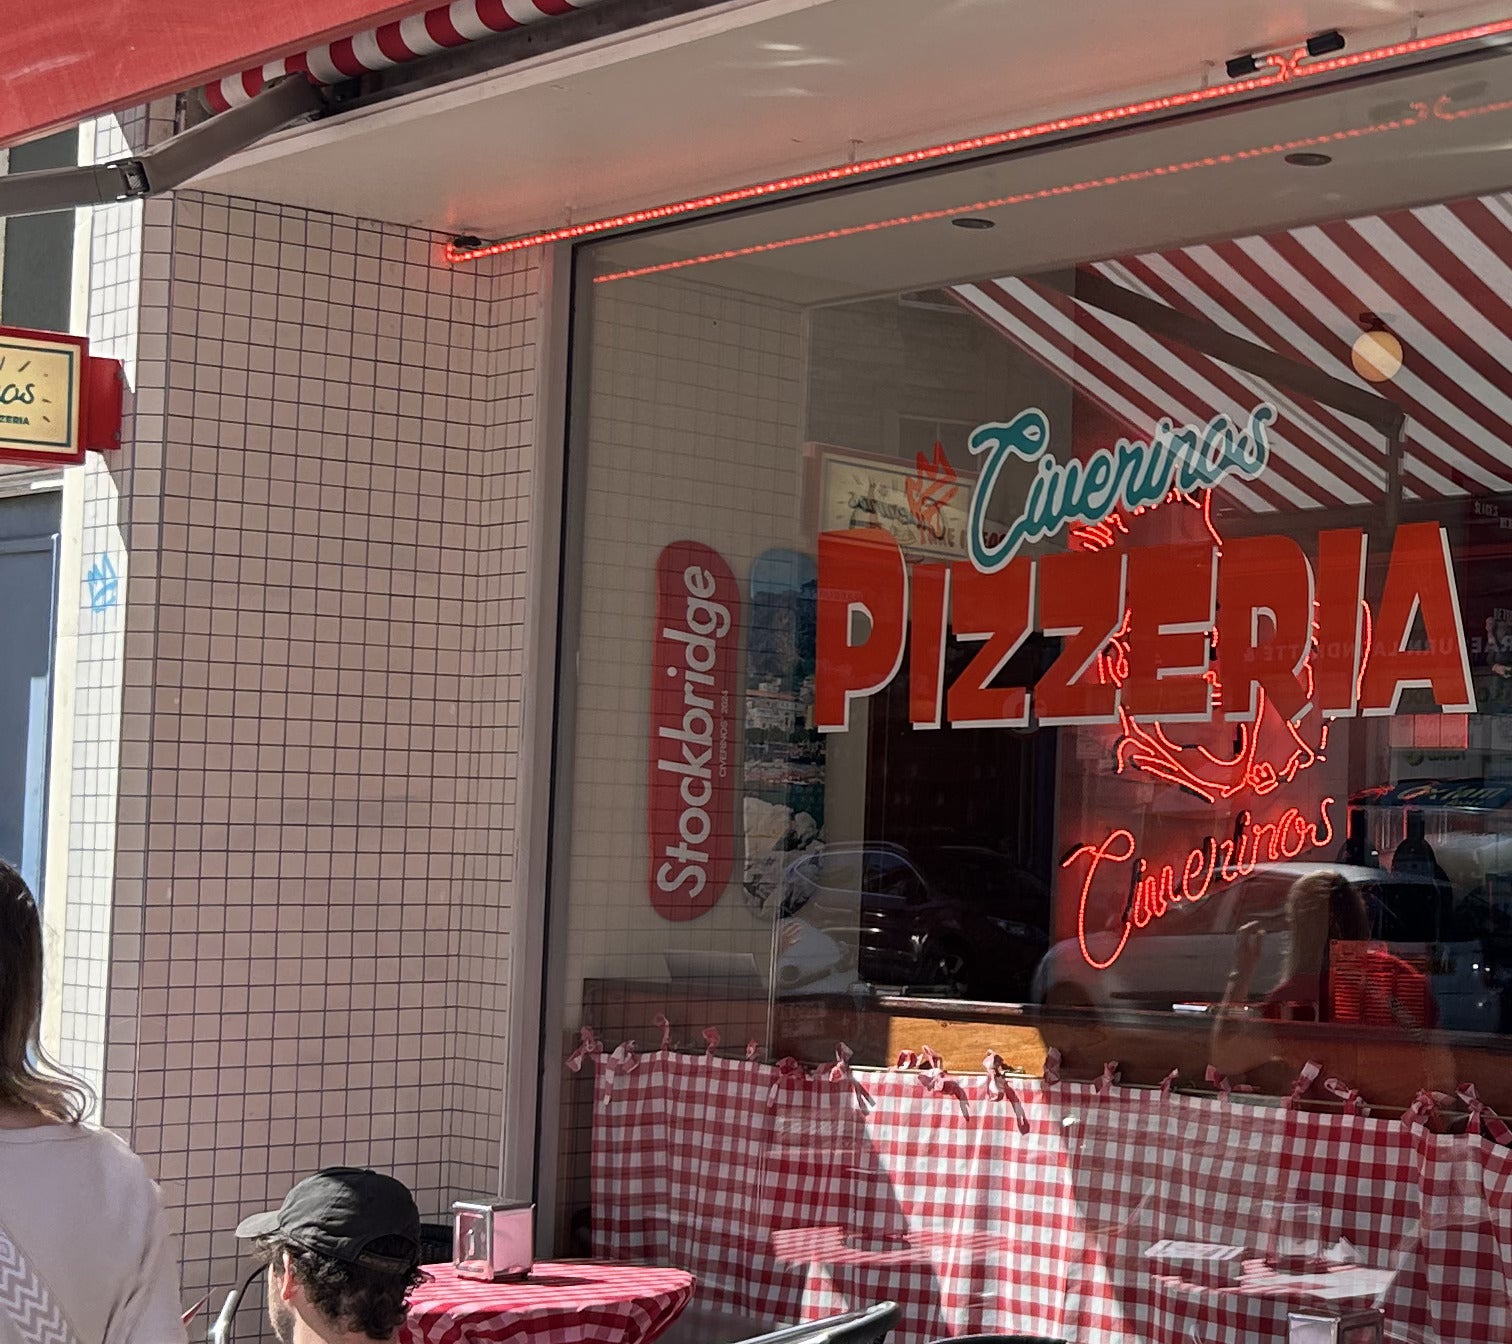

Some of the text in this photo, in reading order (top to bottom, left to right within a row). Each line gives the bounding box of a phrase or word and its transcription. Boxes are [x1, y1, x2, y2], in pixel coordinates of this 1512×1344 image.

[0, 383, 36, 405] os
[968, 402, 1278, 574] Civerinos
[816, 521, 1480, 734] PIZZERIA
[658, 564, 733, 899] Stockbridge
[1061, 796, 1336, 971] Civerinos
